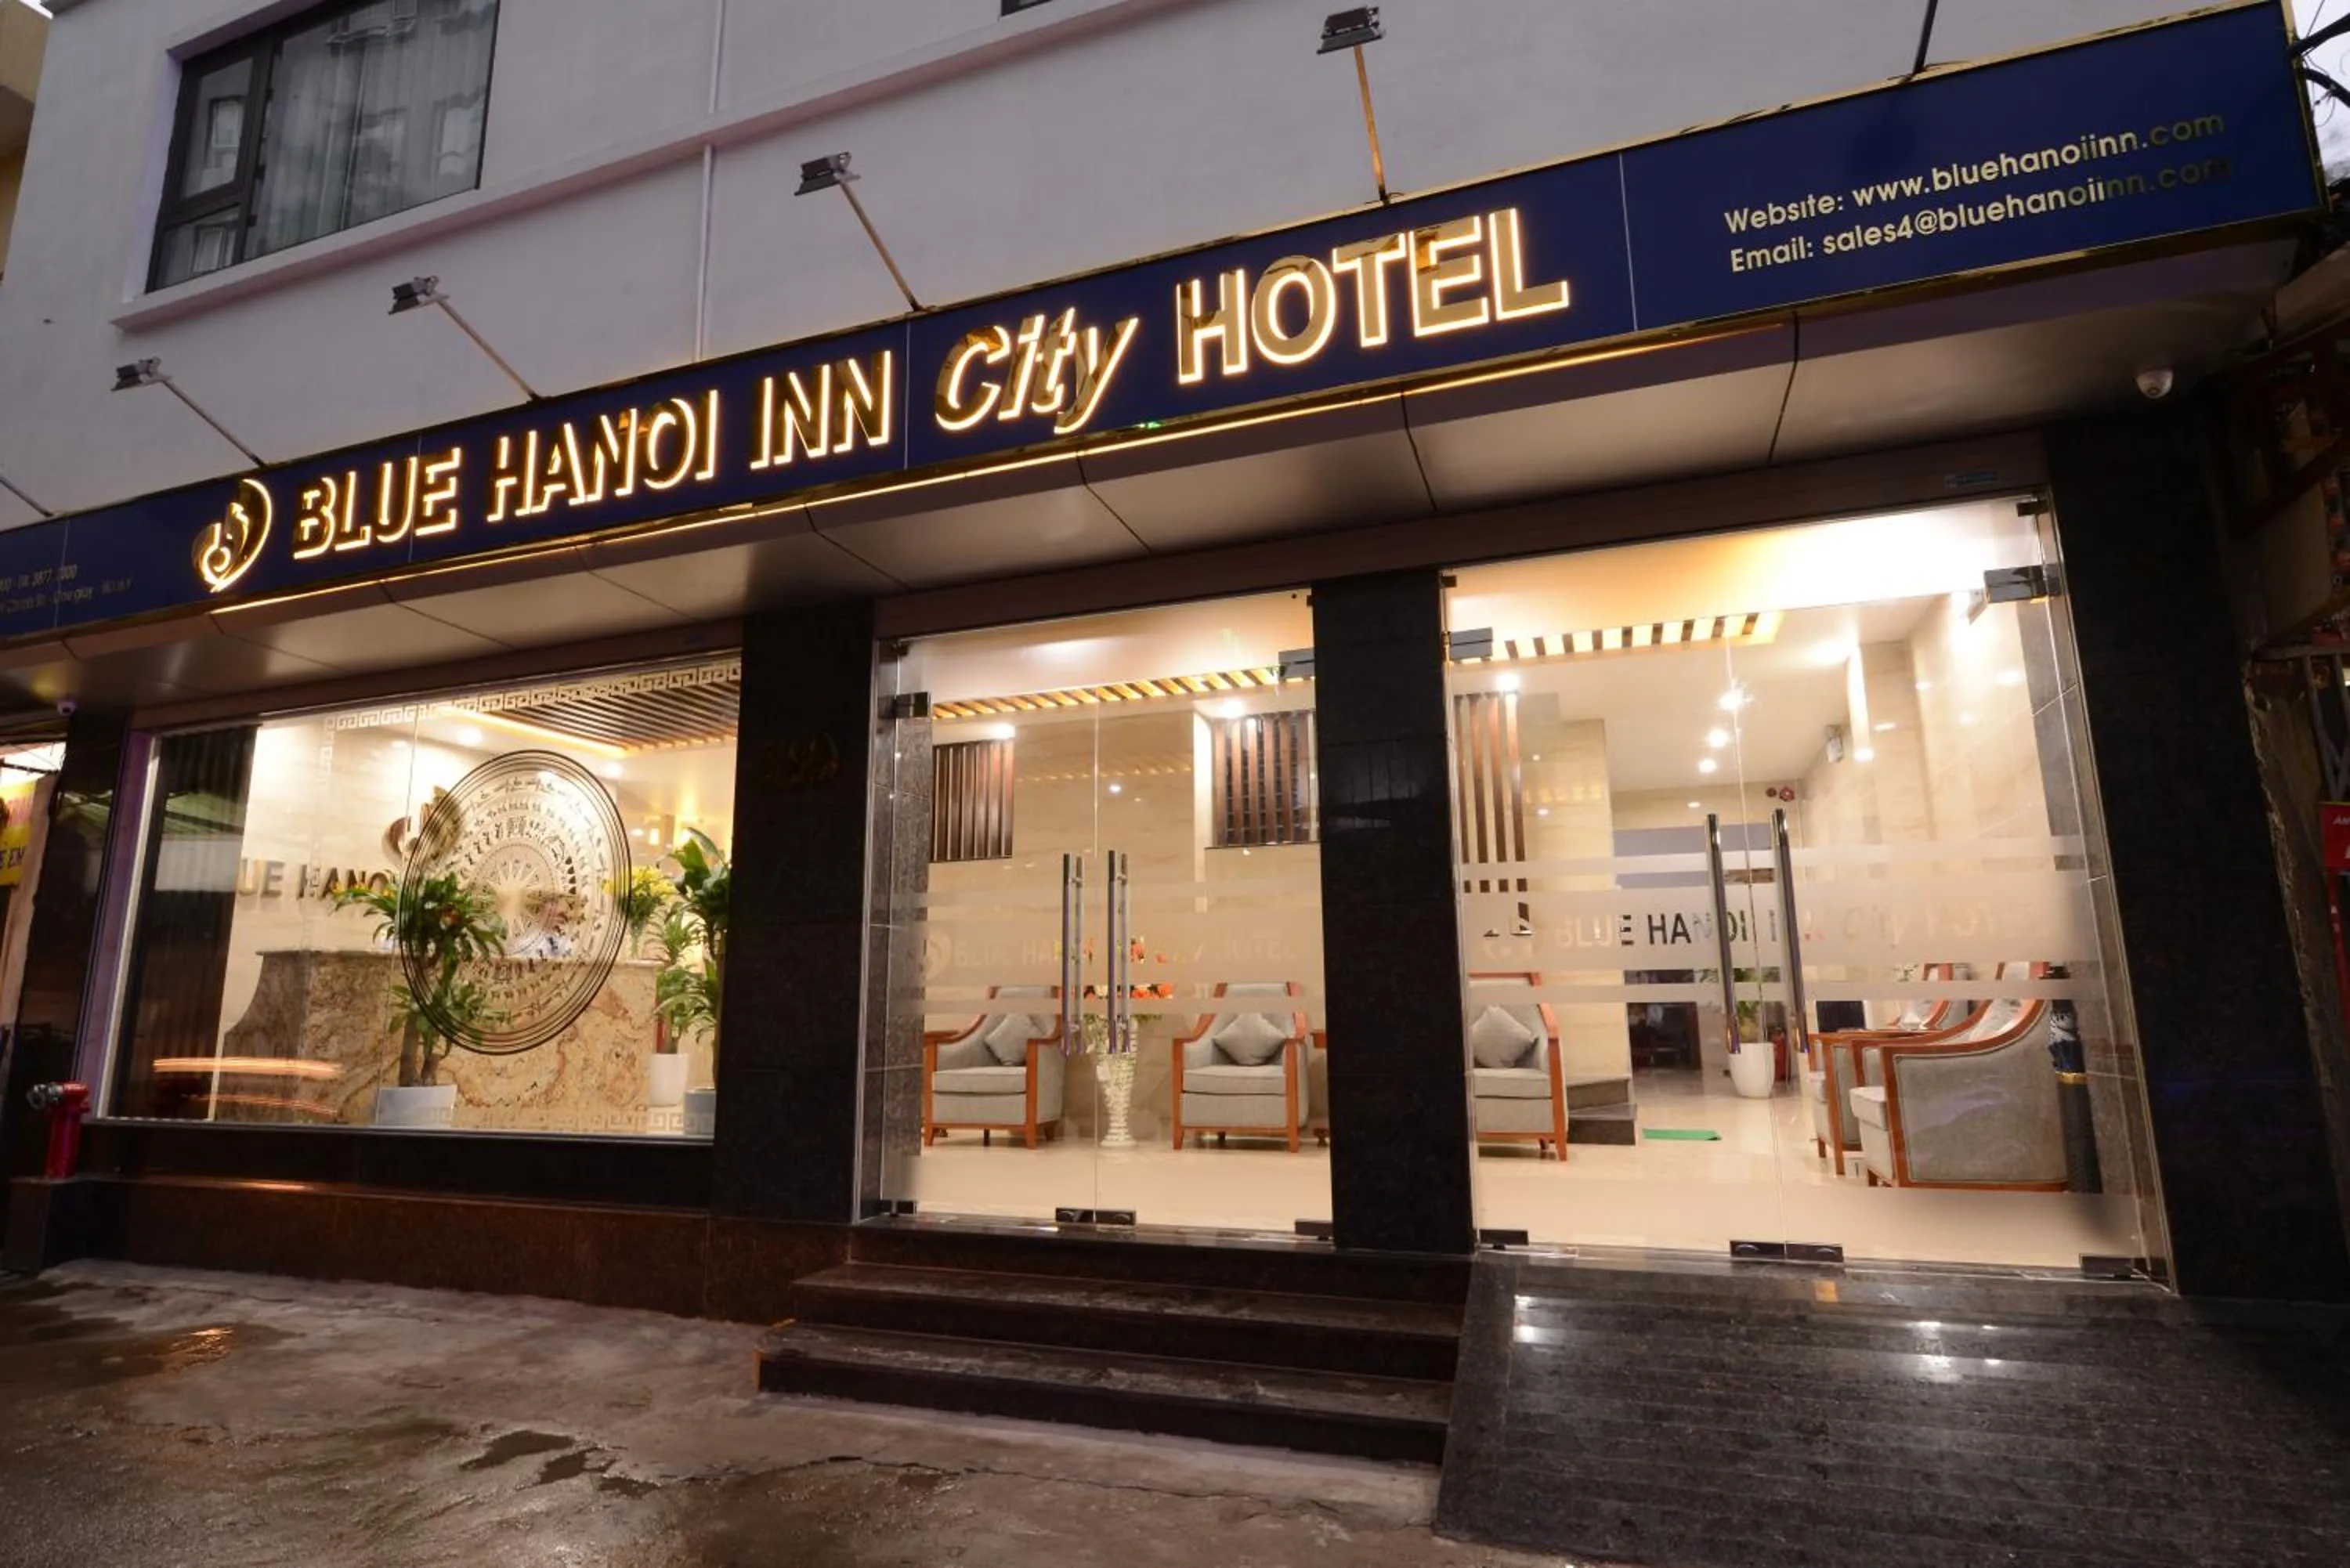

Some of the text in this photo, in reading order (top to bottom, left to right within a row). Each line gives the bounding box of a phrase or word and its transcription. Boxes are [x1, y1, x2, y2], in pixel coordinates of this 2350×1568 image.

[1724, 112, 2225, 234] Website: www.bluehanoiinn.com
[1730, 154, 2234, 273] Email: sales4@bluehanoiinn.com
[292, 207, 1569, 560] BLUE HANOI INN City HOTEL
